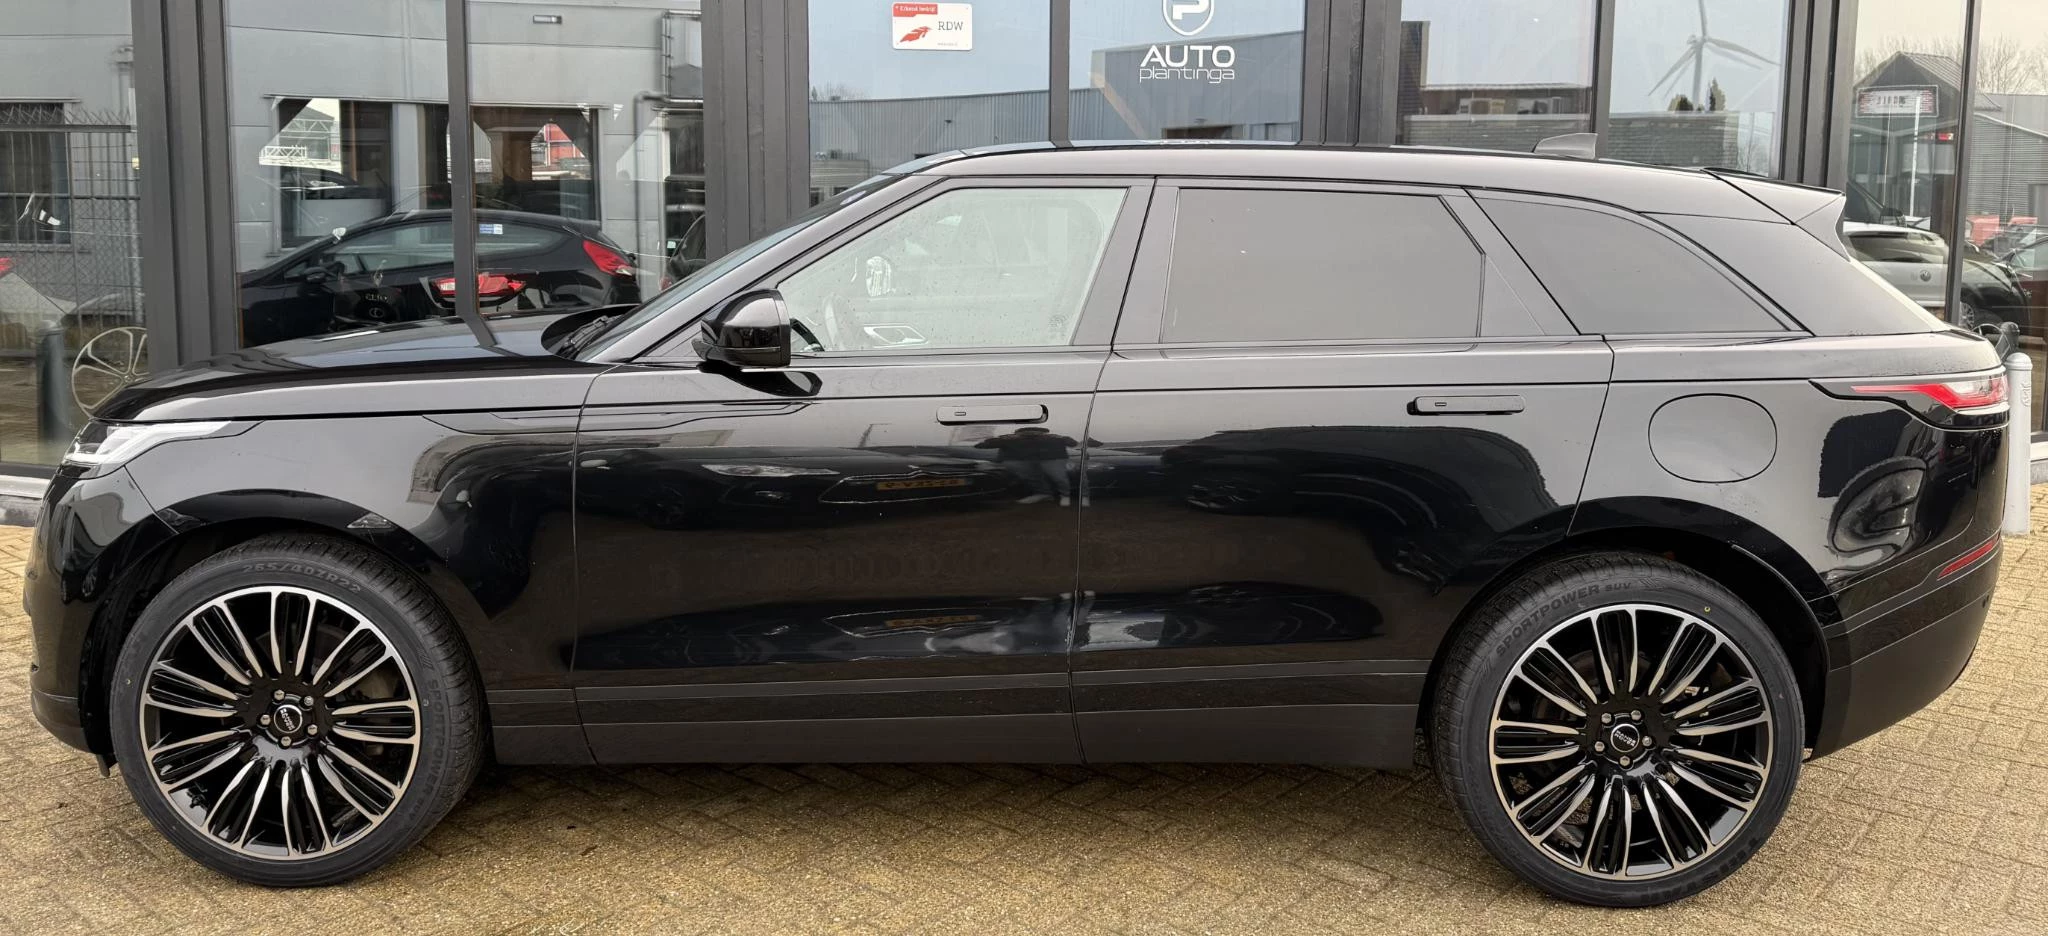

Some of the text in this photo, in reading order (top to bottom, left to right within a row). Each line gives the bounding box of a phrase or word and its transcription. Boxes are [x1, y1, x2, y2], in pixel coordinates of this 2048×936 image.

[938, 21, 963, 31] RDW
[1140, 45, 1235, 67] AUTO
[1139, 66, 1235, 83] plantinga
[1495, 581, 1632, 658] SPORTPOWER SUV
